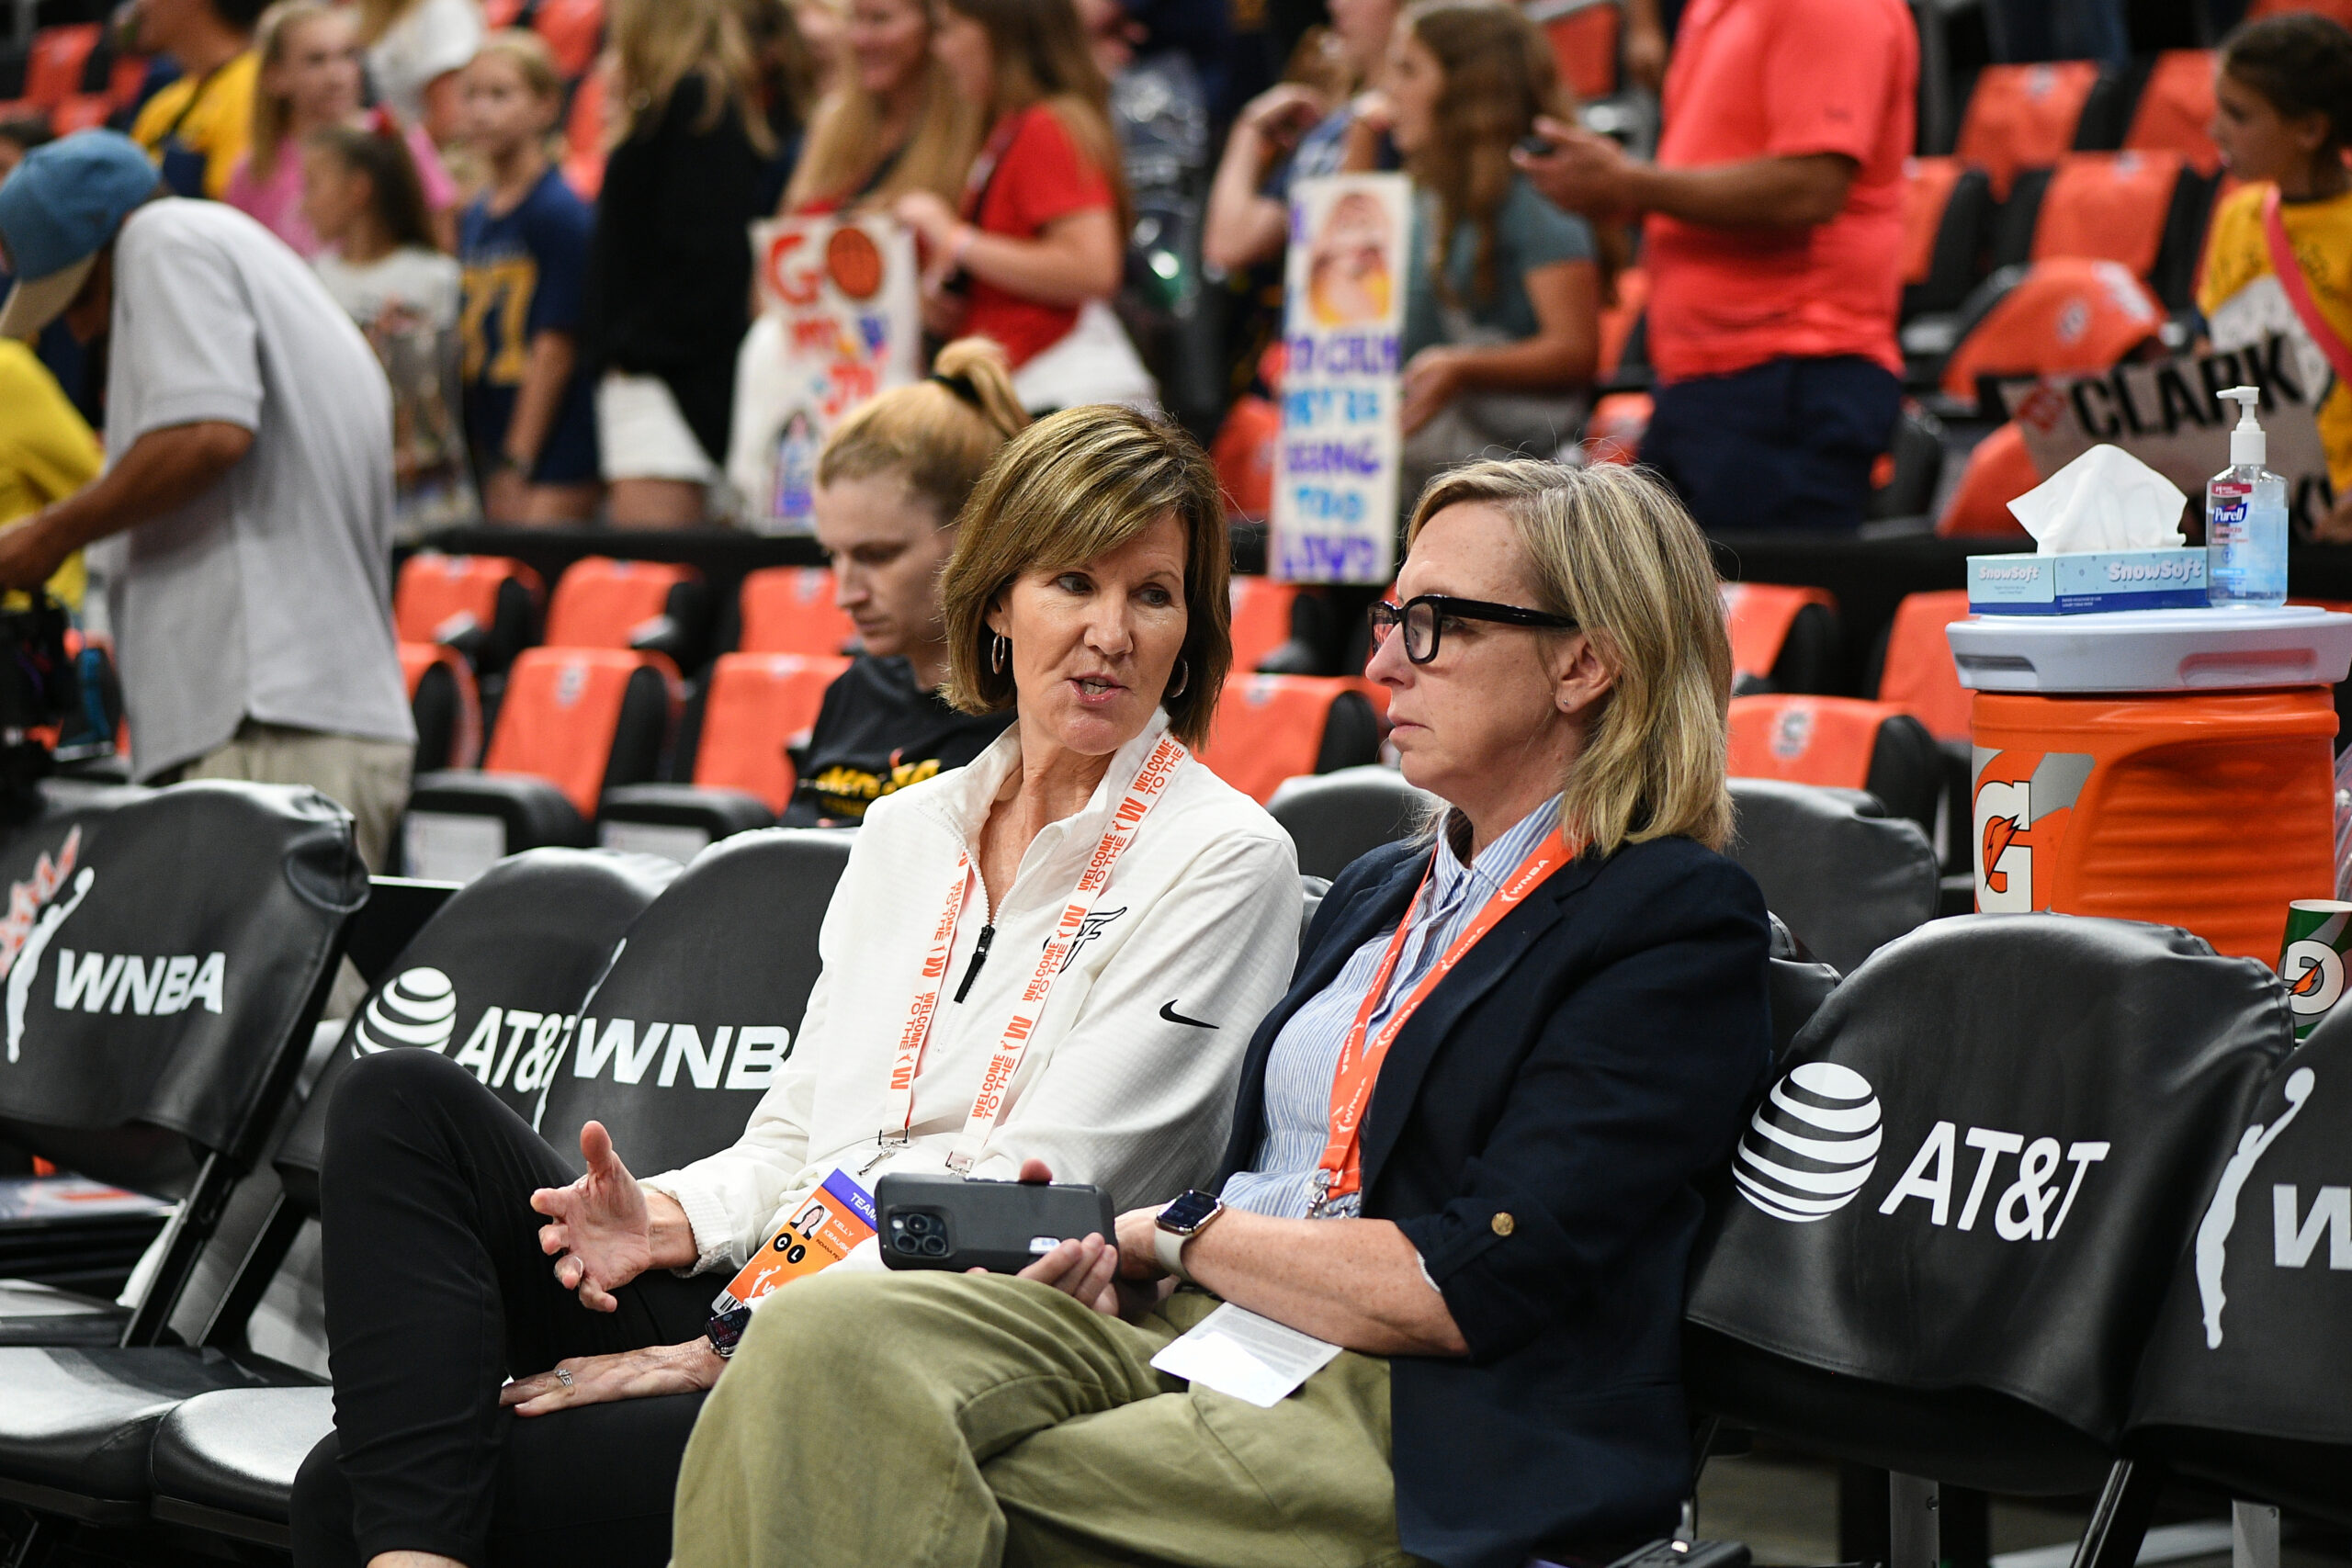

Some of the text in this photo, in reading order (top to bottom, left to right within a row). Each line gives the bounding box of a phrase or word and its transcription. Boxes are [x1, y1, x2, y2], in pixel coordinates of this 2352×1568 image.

[2070, 333, 2305, 439] CLARK
[2214, 507, 2245, 522] Purell
[1978, 565, 2040, 583] SnowSoft
[2109, 558, 2202, 584] SnowSoft
[1133, 739, 1175, 793] WELCOME
[1146, 747, 1184, 795] TO THE
[1115, 796, 1148, 823] W
[1078, 833, 1117, 891] WELCOME
[1089, 837, 1127, 892] TO THE
[1510, 859, 1550, 895] WNBA
[1059, 904, 1088, 928] W
[54, 948, 226, 1016] WNBA
[922, 955, 946, 977] W
[1022, 942, 1059, 1001] WELCOME
[1033, 943, 1069, 1002] TO THE
[899, 993, 925, 1051] TO THE
[908, 991, 935, 1049] WELCOME
[1004, 1015, 1033, 1040] W
[890, 1066, 912, 1089] W
[972, 1054, 1005, 1118] WELCOME
[983, 1056, 1016, 1120] TO THE
[1878, 1121, 2110, 1241] AT&T
[777, 1236, 787, 1248] C
[823, 1228, 852, 1253] KRAUSK
[833, 1218, 854, 1237] KELLY
[790, 1248, 800, 1261] L
